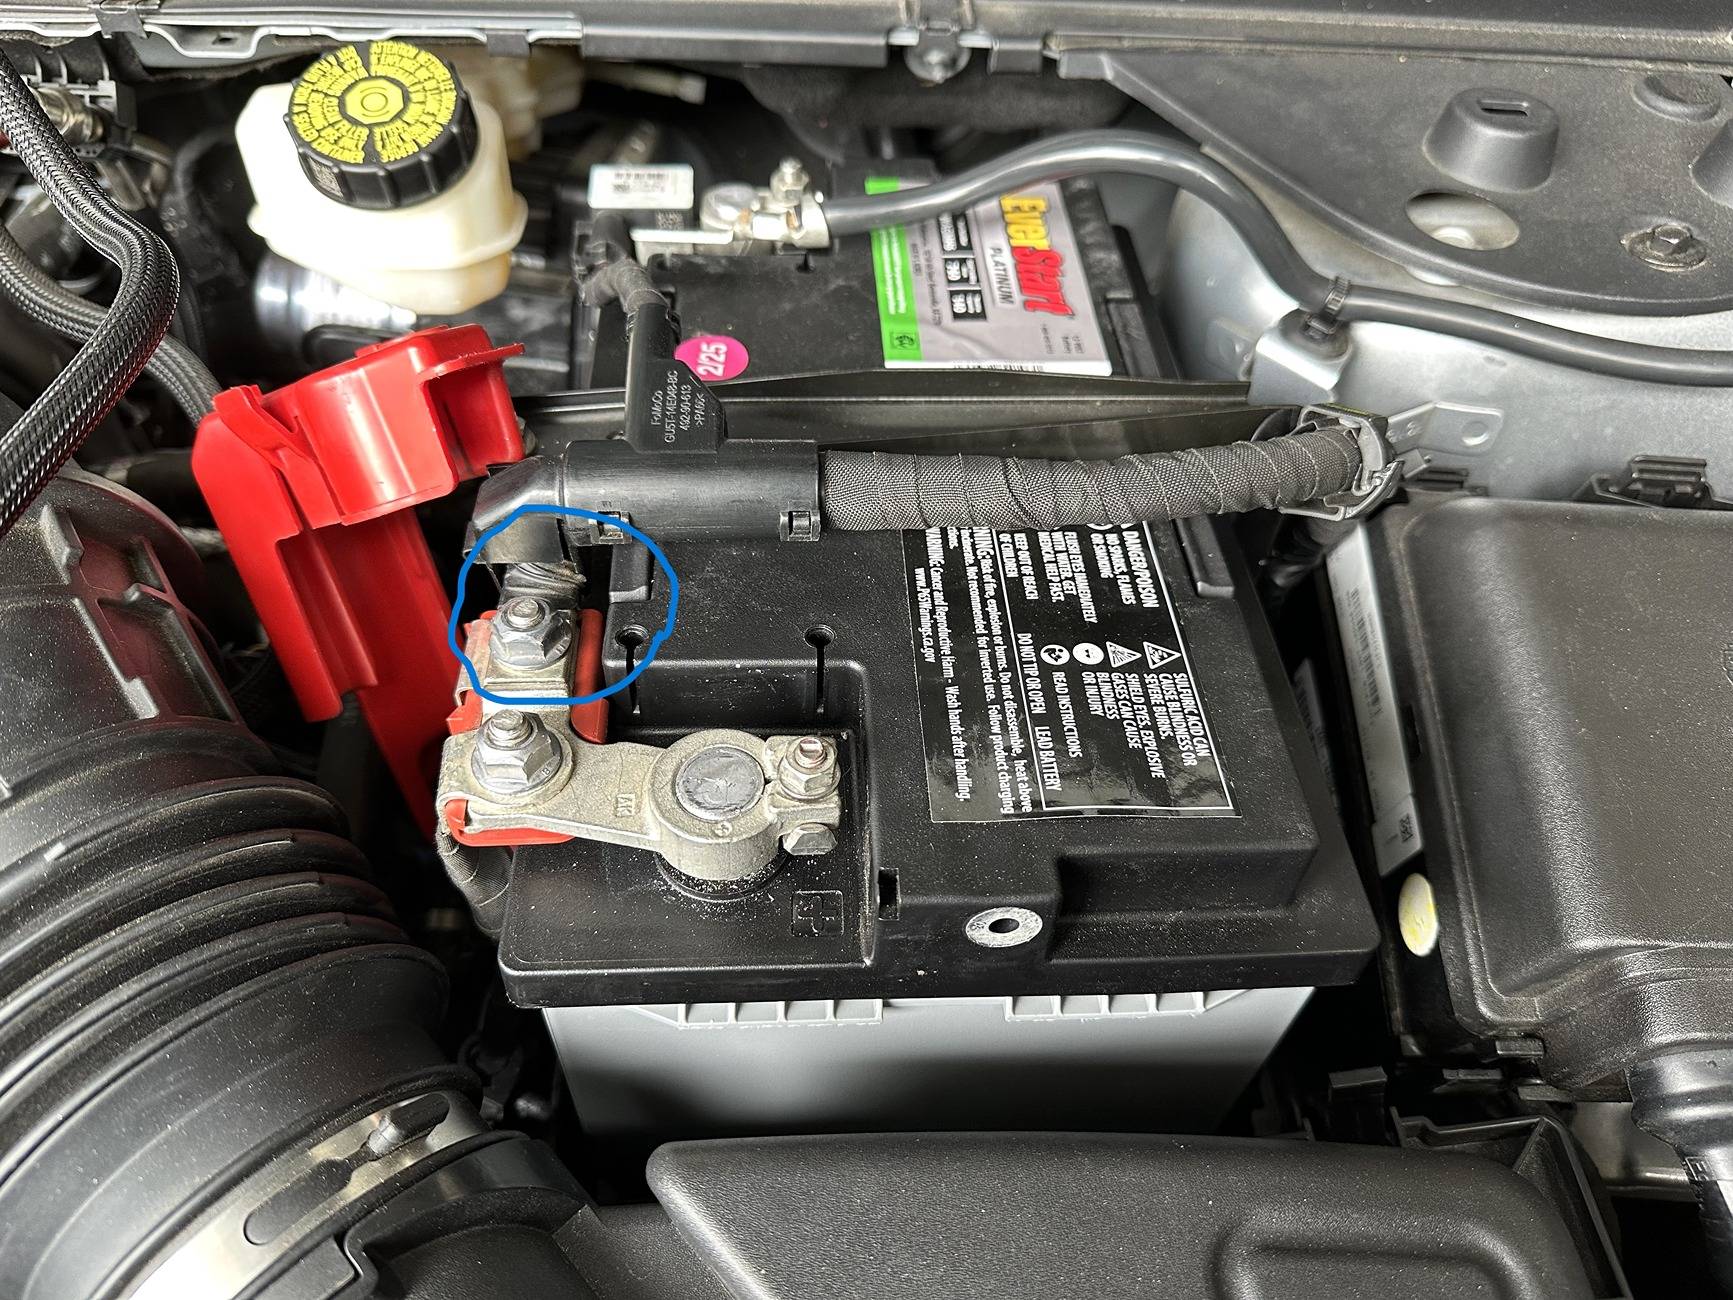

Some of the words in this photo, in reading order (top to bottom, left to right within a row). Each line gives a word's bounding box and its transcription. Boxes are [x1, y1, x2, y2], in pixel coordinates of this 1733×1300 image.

[1000, 196, 1076, 317] EverStart
[989, 247, 1014, 304] PLATINUM
[696, 342, 727, 376] 2/25
[650, 390, 663, 425] FoMoCo
[680, 384, 692, 430] 492-90-613
[925, 527, 945, 567] WARNING:
[960, 529, 976, 566] incinerate.
[973, 527, 994, 559] NING:
[999, 534, 1012, 543] OF
[1014, 533, 1028, 550] KEEP
[1037, 532, 1055, 563] MEDICAL
[1051, 531, 1067, 551] WITH
[1064, 532, 1081, 554] FLUSH
[1090, 533, 1104, 544] OR
[980, 559, 994, 574] Risk
[1001, 543, 1019, 577] CHILDREN
[1018, 551, 1032, 565] OUT
[1021, 566, 1033, 575] OF
[1056, 552, 1072, 580] WATER.
[1070, 555, 1085, 572] EYES
[1093, 545, 1113, 578] SMOKING
[1105, 534, 1120, 545] NO
[1116, 575, 1136, 605] FLAMES
[1122, 530, 1160, 608] DANGER/POISON
[930, 568, 944, 590] Cancer
[966, 566, 978, 580] Not
[983, 574, 996, 582] of
[1045, 563, 1060, 582] HELP
[933, 591, 948, 605] and
[984, 583, 997, 598] fire,
[1022, 576, 1038, 599] REACH
[1049, 583, 1064, 602] FAST.
[1062, 580, 1077, 595] GET
[1074, 573, 1098, 623] IMMEDIATELY
[915, 568, 936, 663] www.P65Warnings.ca.gov
[968, 581, 988, 634] recommended
[985, 599, 1002, 635] explosion
[933, 606, 953, 655] Reproductive
[976, 636, 990, 648] for
[994, 636, 1005, 645] or
[1016, 633, 1033, 644] DO
[979, 650, 996, 683] inverted
[994, 646, 1008, 671] burns.
[1019, 646, 1037, 662] NOT
[941, 656, 956, 678] Harm
[999, 672, 1013, 683] Do
[1023, 663, 1038, 675] TIP
[1082, 672, 1095, 684] OR
[985, 684, 996, 701] use.
[1001, 685, 1014, 699] not
[1026, 678, 1041, 690] OR
[1052, 672, 1067, 694] READ
[1111, 672, 1126, 699] GASES
[1125, 673, 1145, 703] SHIELD
[1143, 674, 1164, 704] SEVERE
[1158, 673, 1178, 700] CAUSE
[1173, 673, 1198, 714] SULFURIC
[944, 686, 961, 708] Wash
[1027, 690, 1046, 713] OPEN
[1084, 685, 1104, 716] INJURY
[1096, 672, 1120, 720] BLINDNESS
[987, 705, 1002, 733] Follow
[1117, 700, 1134, 718] CAN
[1133, 705, 1151, 728] EYES.
[948, 709, 963, 735] hands
[1003, 700, 1024, 756] disassemble,
[1056, 695, 1082, 758] INSTRUCTIONS
[1123, 720, 1142, 749] CAUSE
[1153, 706, 1173, 739] BURNS.
[1166, 702, 1194, 750] BLINDNESS
[1186, 715, 1204, 736] ACID
[951, 736, 968, 757] after
[1034, 726, 1053, 749] LEAD
[1193, 737, 1211, 756] CAN
[989, 735, 1010, 770] product
[1140, 730, 1165, 778] EXPLOSIVE
[1181, 752, 1197, 766] OR
[954, 759, 972, 802] handling.
[1014, 760, 1029, 781] heat
[1039, 751, 1062, 791] BATTERY
[998, 772, 1016, 814] charging
[1017, 783, 1033, 812] above
